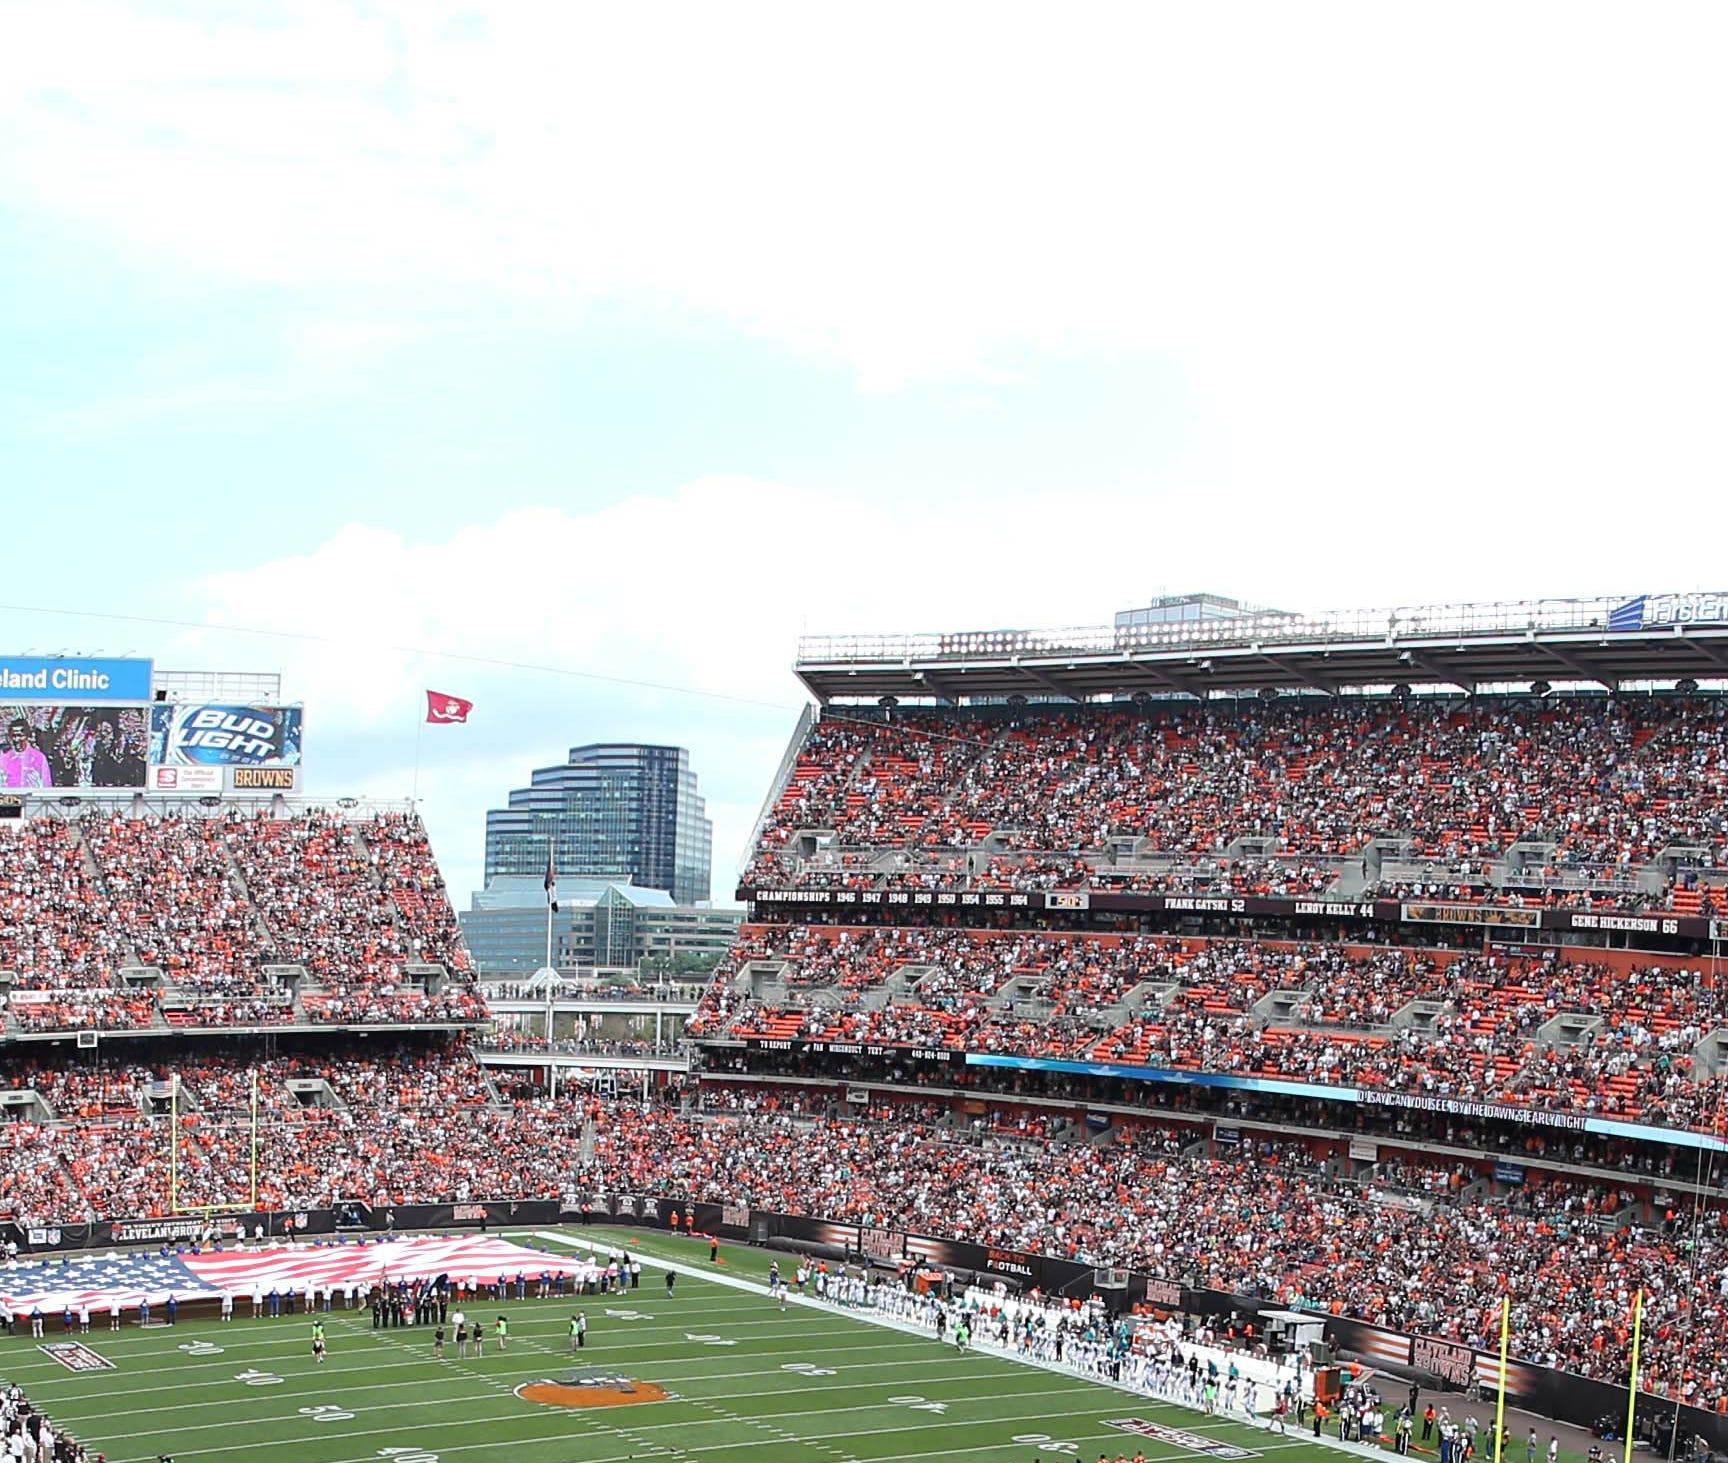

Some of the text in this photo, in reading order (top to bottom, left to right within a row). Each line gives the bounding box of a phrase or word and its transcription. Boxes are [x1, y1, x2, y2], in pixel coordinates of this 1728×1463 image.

[52, 668, 111, 690] Clinic
[191, 710, 275, 739] BUD
[173, 728, 276, 757] LIGHT
[235, 769, 293, 787] BROWNS
[756, 891, 830, 902] CHAMPIONSHIPS
[863, 893, 880, 903] 1947
[962, 894, 979, 905] 1954
[985, 895, 1004, 905] 1955
[1165, 899, 1245, 912] FRANK GATSKI 52
[1295, 902, 1374, 917] LEROY KELLY 44
[1571, 914, 1678, 934] GENE HICKERSON 66
[769, 1041, 791, 1050] REPORT
[867, 1046, 883, 1055] TEXT
[1370, 1093, 1387, 1105] SAY
[1389, 1095, 1408, 1107] CAN
[1409, 1097, 1428, 1110] YOU
[1451, 1101, 1464, 1114] BY
[1467, 1103, 1484, 1117] THE
[1526, 1110, 1554, 1125] EARLY
[1558, 1113, 1585, 1130] LIGHT
[861, 1228, 904, 1247] CLEVELAND
[1414, 1338, 1472, 1364] CLEVELAND
[298, 1404, 355, 1422] 50
[887, 1396, 950, 1414] 40
[1011, 1434, 1079, 1455] 30
